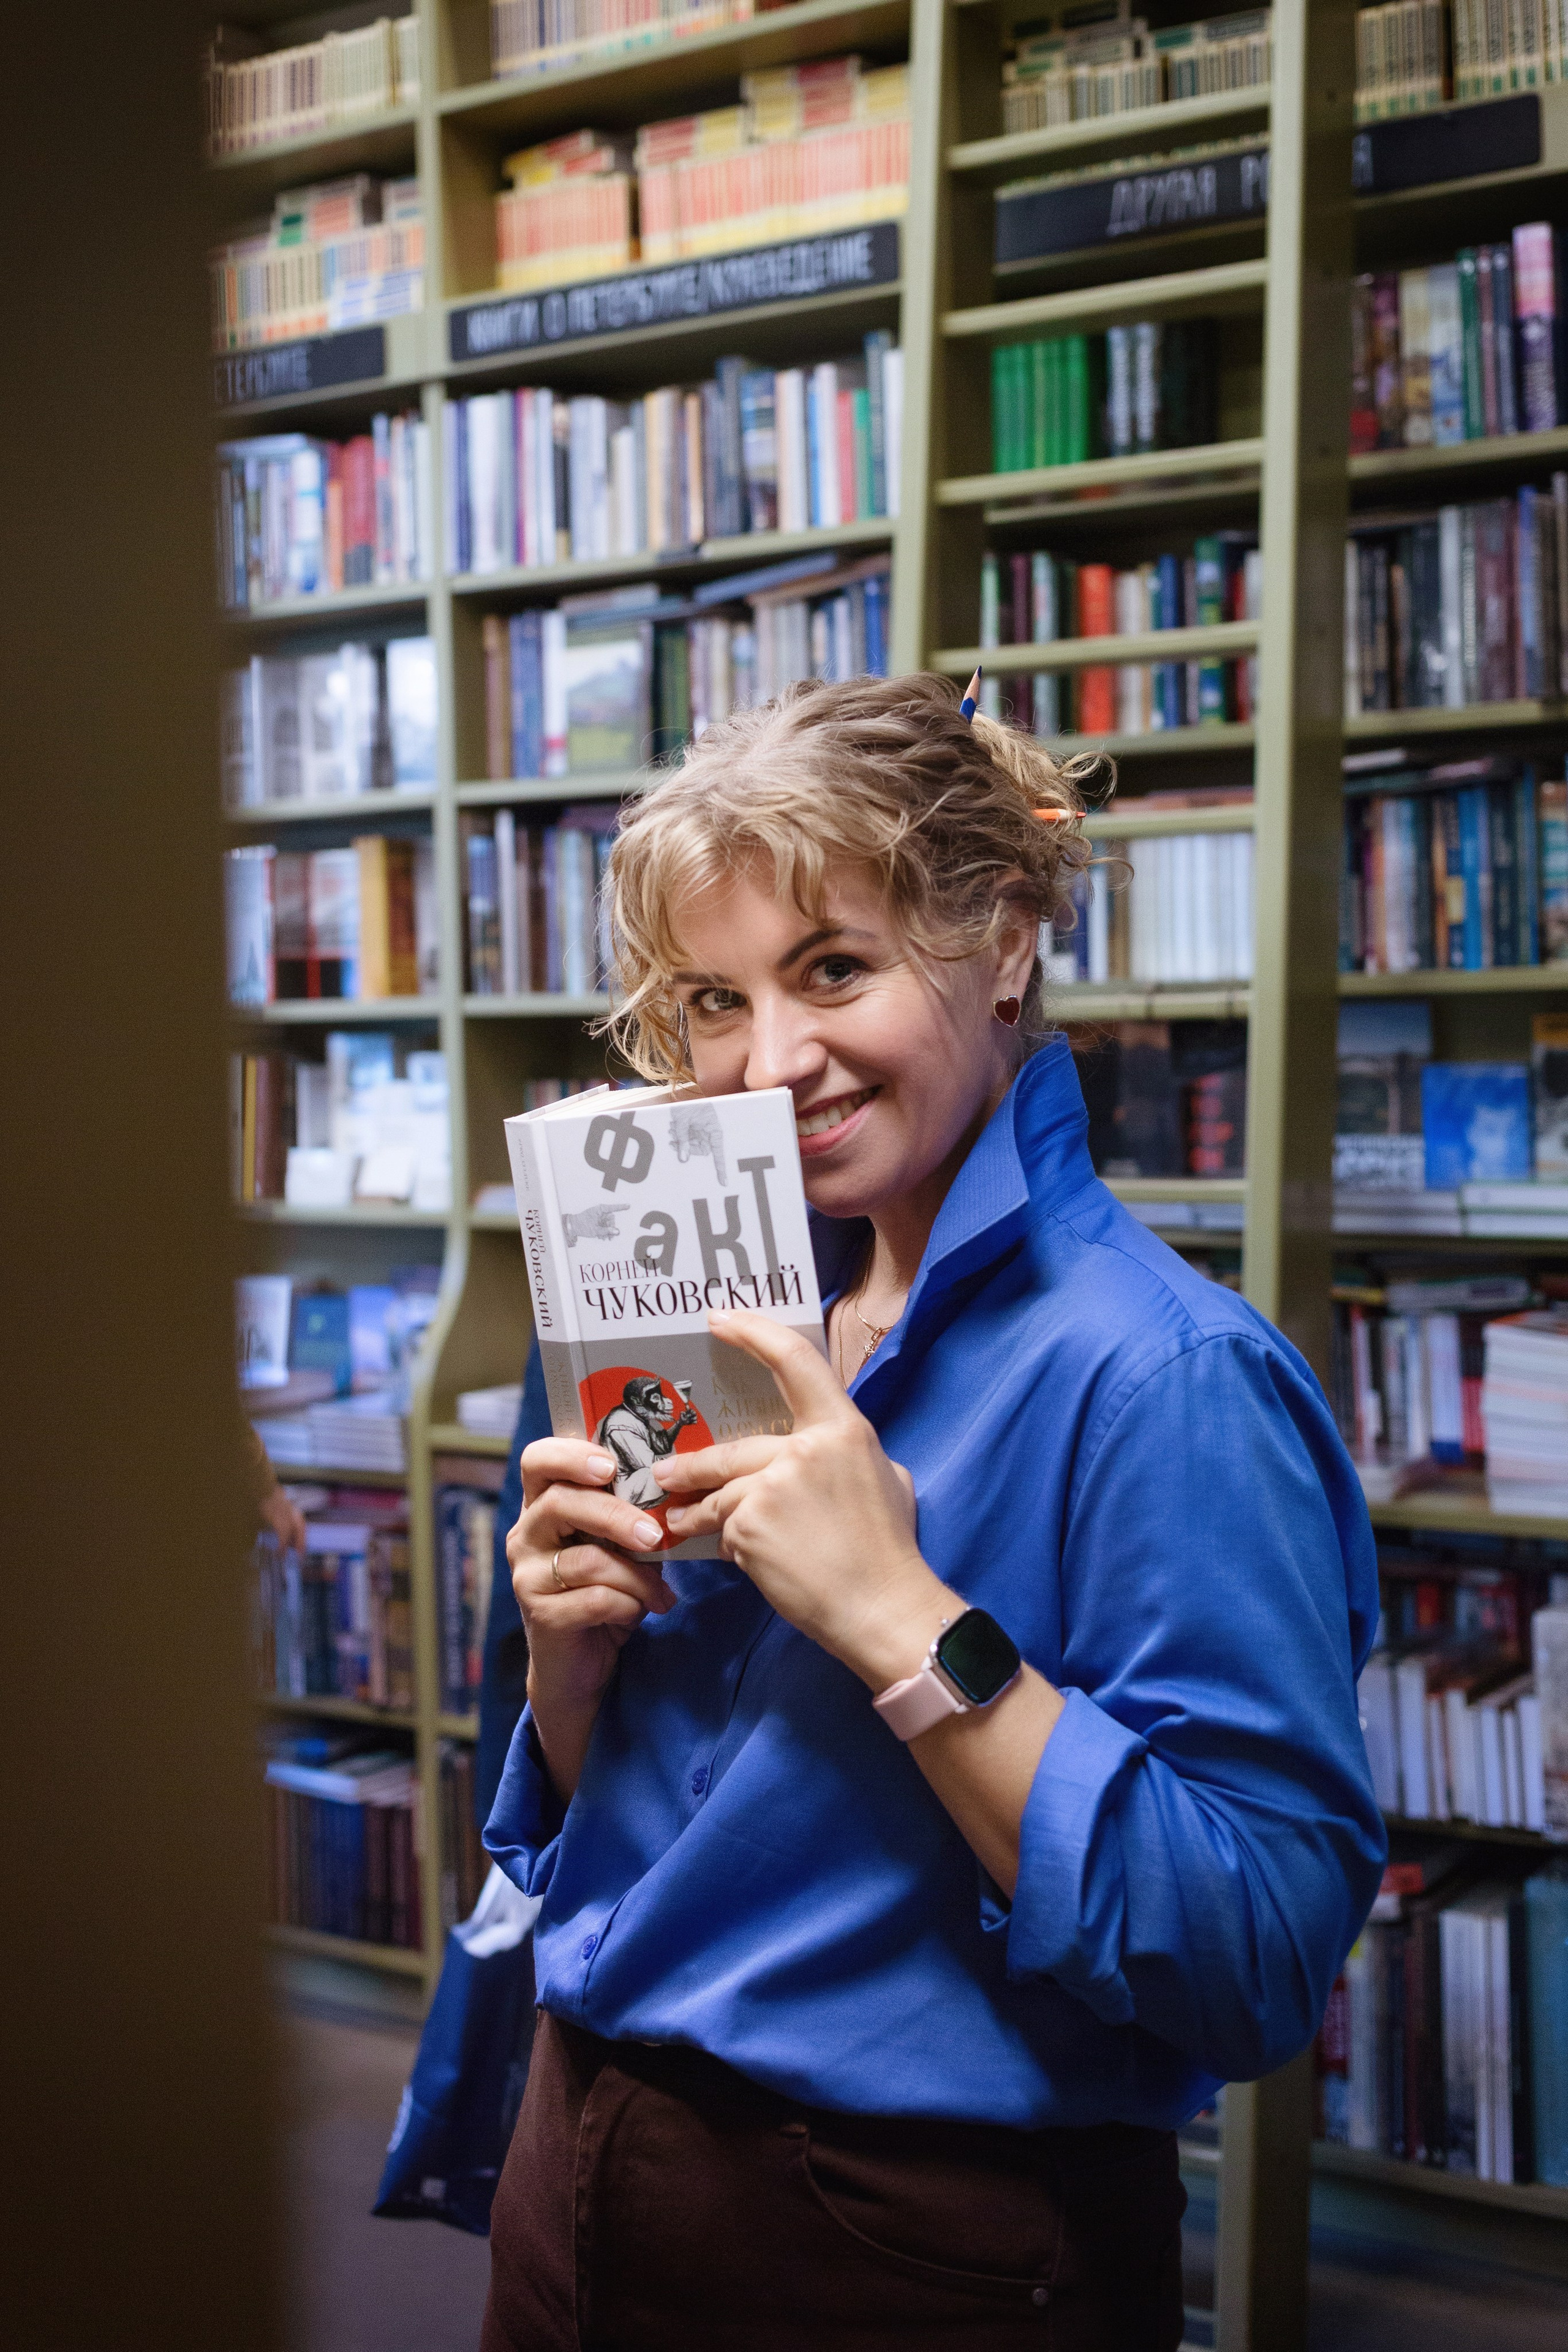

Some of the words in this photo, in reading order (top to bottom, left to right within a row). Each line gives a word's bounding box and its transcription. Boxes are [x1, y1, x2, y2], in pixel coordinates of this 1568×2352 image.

[525, 1210, 552, 1328] ЧУКОВСКИЙ
[579, 1254, 658, 1283] КОРНЕЙ
[583, 1264, 806, 1321] ЧУКОВСКИЙ
